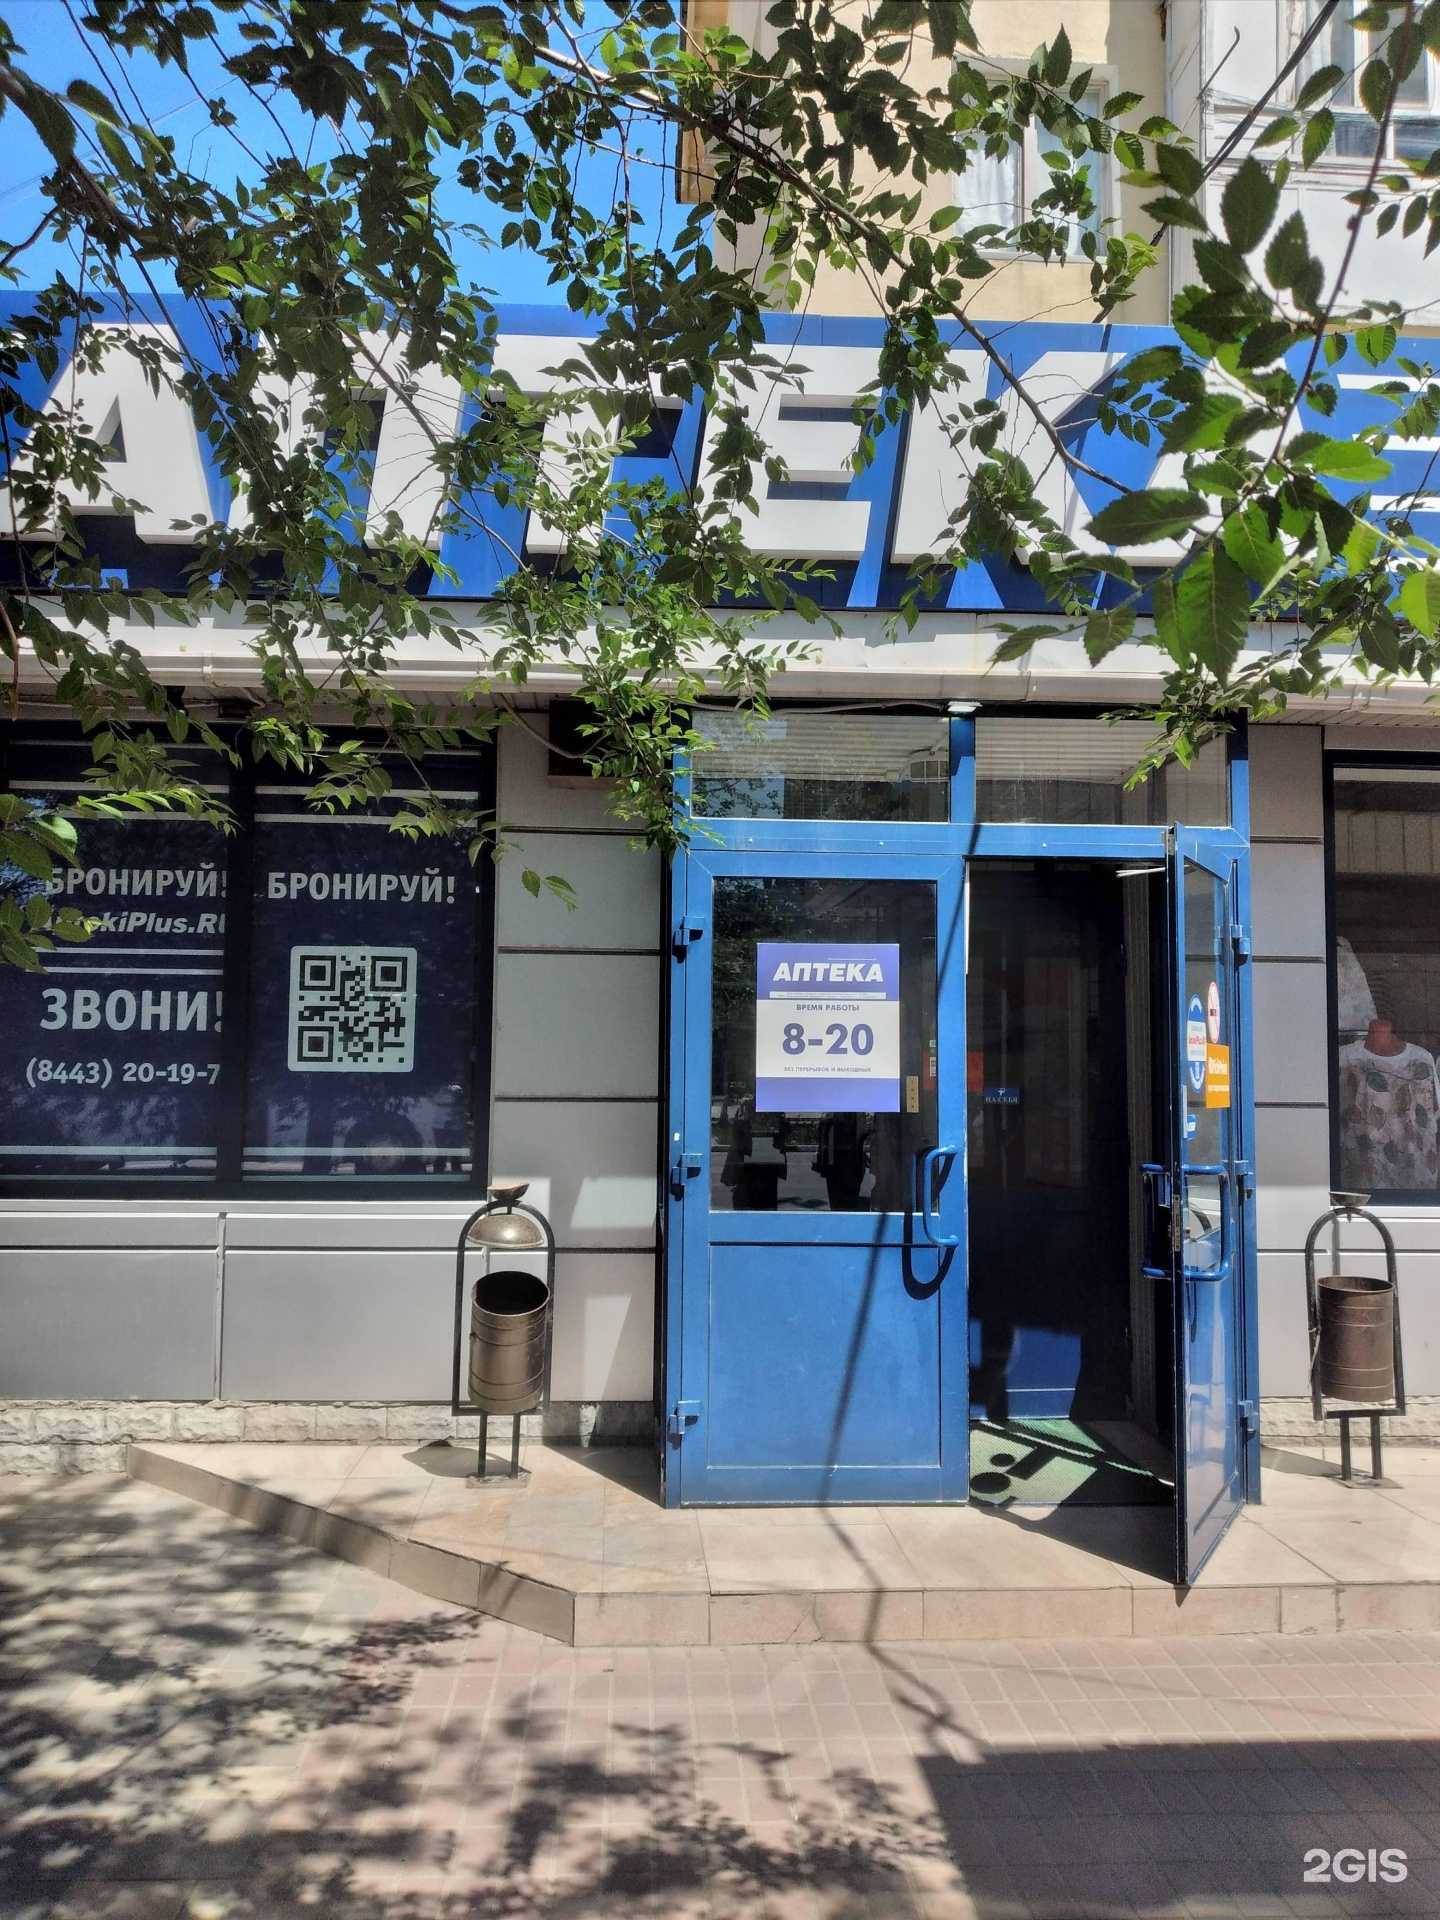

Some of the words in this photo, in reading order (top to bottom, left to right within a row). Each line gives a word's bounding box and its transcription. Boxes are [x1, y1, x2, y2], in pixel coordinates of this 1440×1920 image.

[267, 868, 456, 904] БРОНИРУЙ!
[772, 962, 883, 983] АПТЕКА
[40, 988, 223, 1033] ЗВОНИ!
[825, 1004, 860, 1012] РАБОТЫ
[782, 1023, 874, 1056] 8-20
[25, 1057, 113, 1089] (8443)
[122, 1062, 221, 1087] 20-19-7
